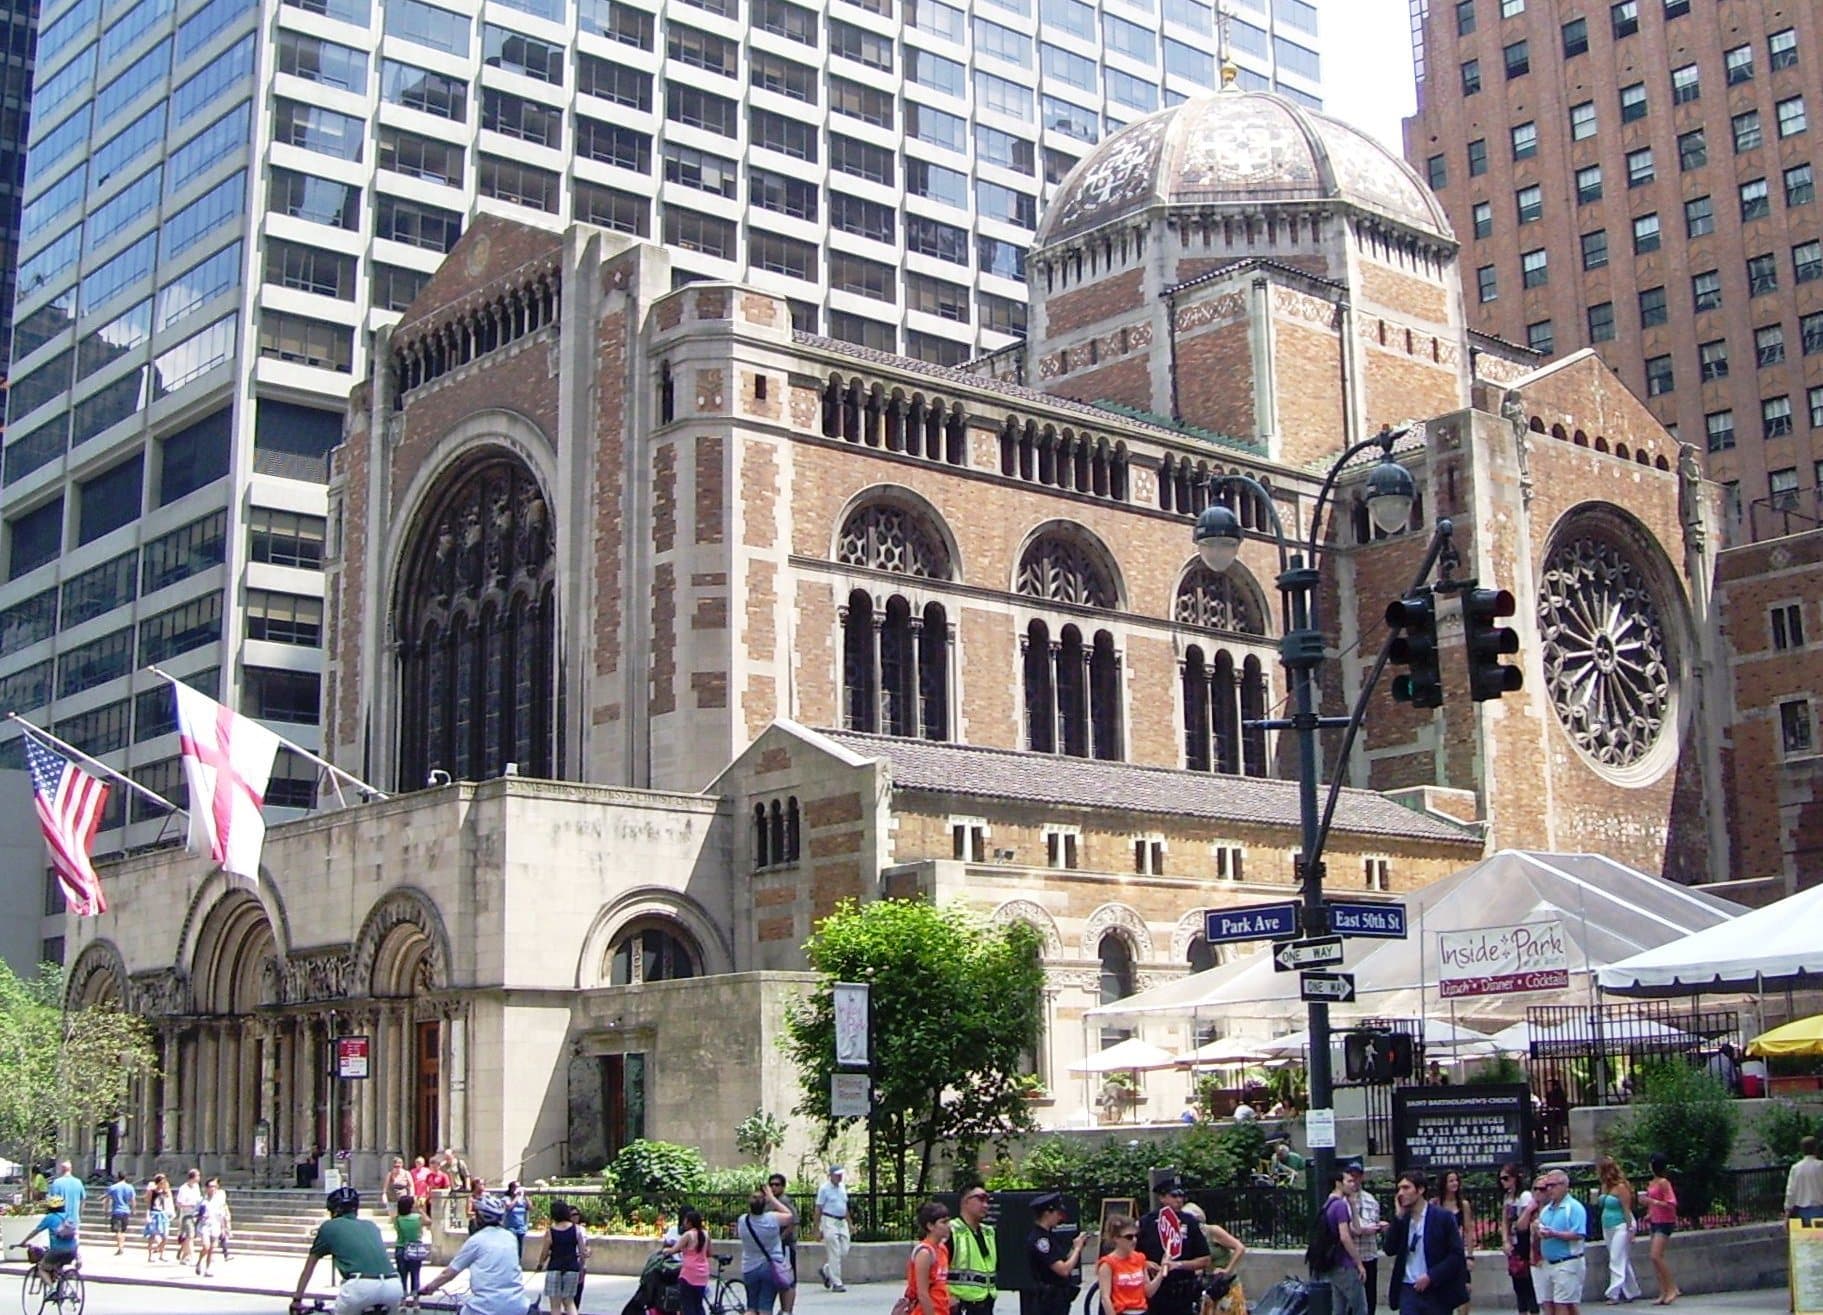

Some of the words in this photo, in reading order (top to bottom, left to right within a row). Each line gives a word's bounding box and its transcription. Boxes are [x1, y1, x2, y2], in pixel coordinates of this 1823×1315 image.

[1221, 916, 1252, 935] Park
[1254, 915, 1281, 931] Ave
[1335, 911, 1360, 928] East
[1362, 912, 1386, 929] 50th
[1388, 913, 1400, 930] St
[1282, 950, 1302, 962] ONE
[1313, 946, 1333, 959] WAY
[1440, 935, 1499, 968] Inside
[1511, 928, 1563, 971] Park
[1307, 980, 1323, 992] ONE
[1330, 981, 1346, 993] WAY
[1441, 979, 1469, 996] Lunch
[1481, 976, 1514, 992] Dinner
[1418, 1117, 1455, 1126] SUNDAY
[1461, 1115, 1504, 1125] SERVICES
[1412, 1146, 1431, 1155] WED
[1461, 1144, 1479, 1154] SAT
[1160, 1215, 1182, 1247] STOP
